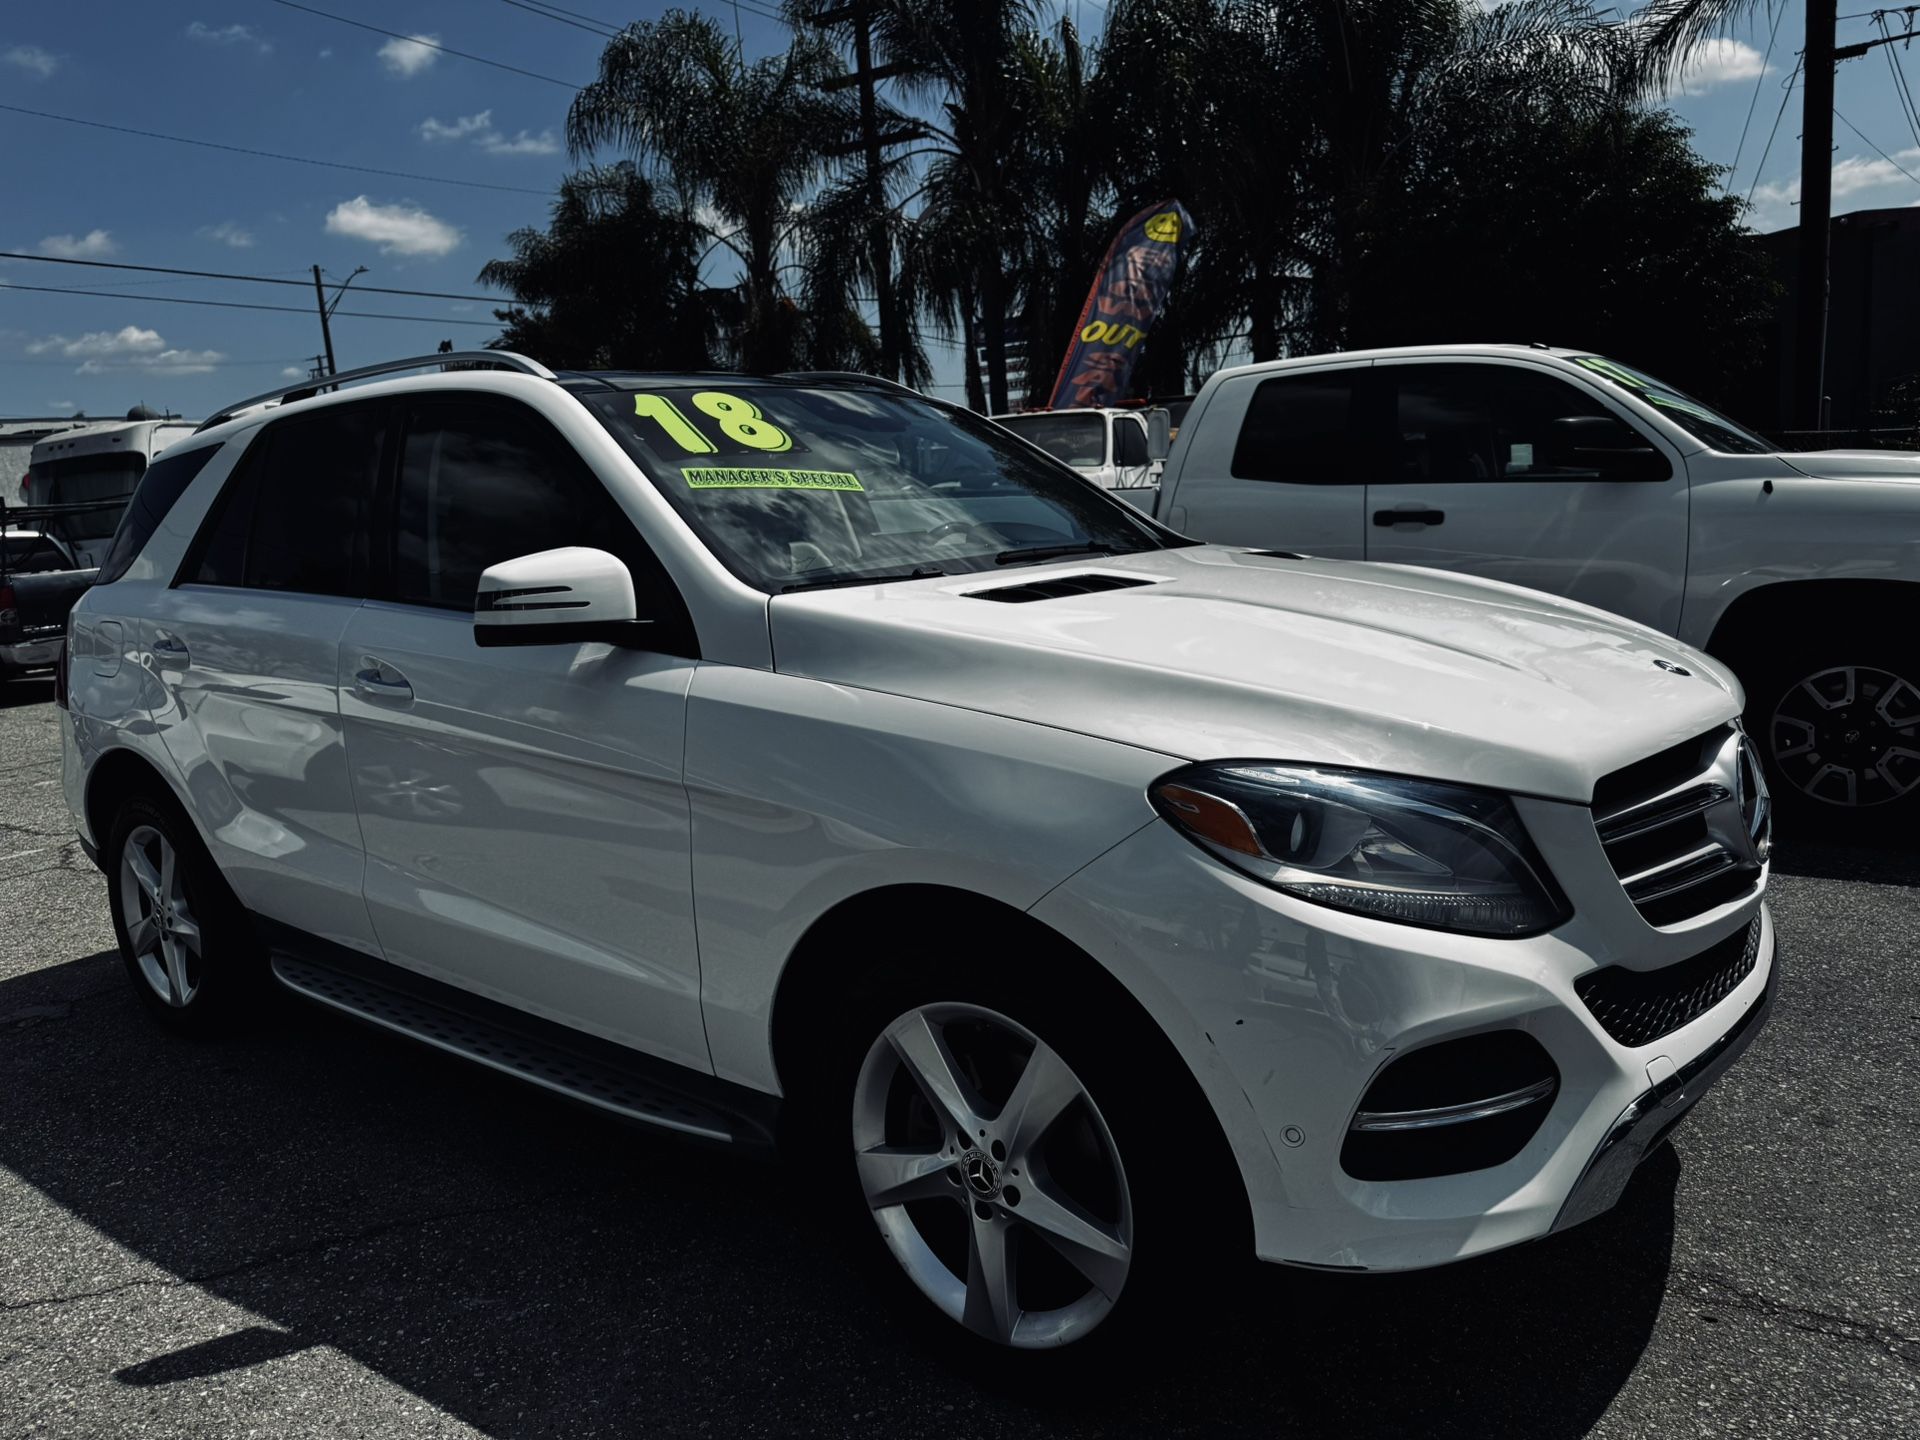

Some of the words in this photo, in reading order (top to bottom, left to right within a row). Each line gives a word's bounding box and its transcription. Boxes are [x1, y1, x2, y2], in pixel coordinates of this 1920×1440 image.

[1081, 320, 1148, 348] OUT
[634, 392, 792, 453] 18
[687, 470, 787, 485] MANAGER'S
[790, 471, 858, 488] SPECIAL
